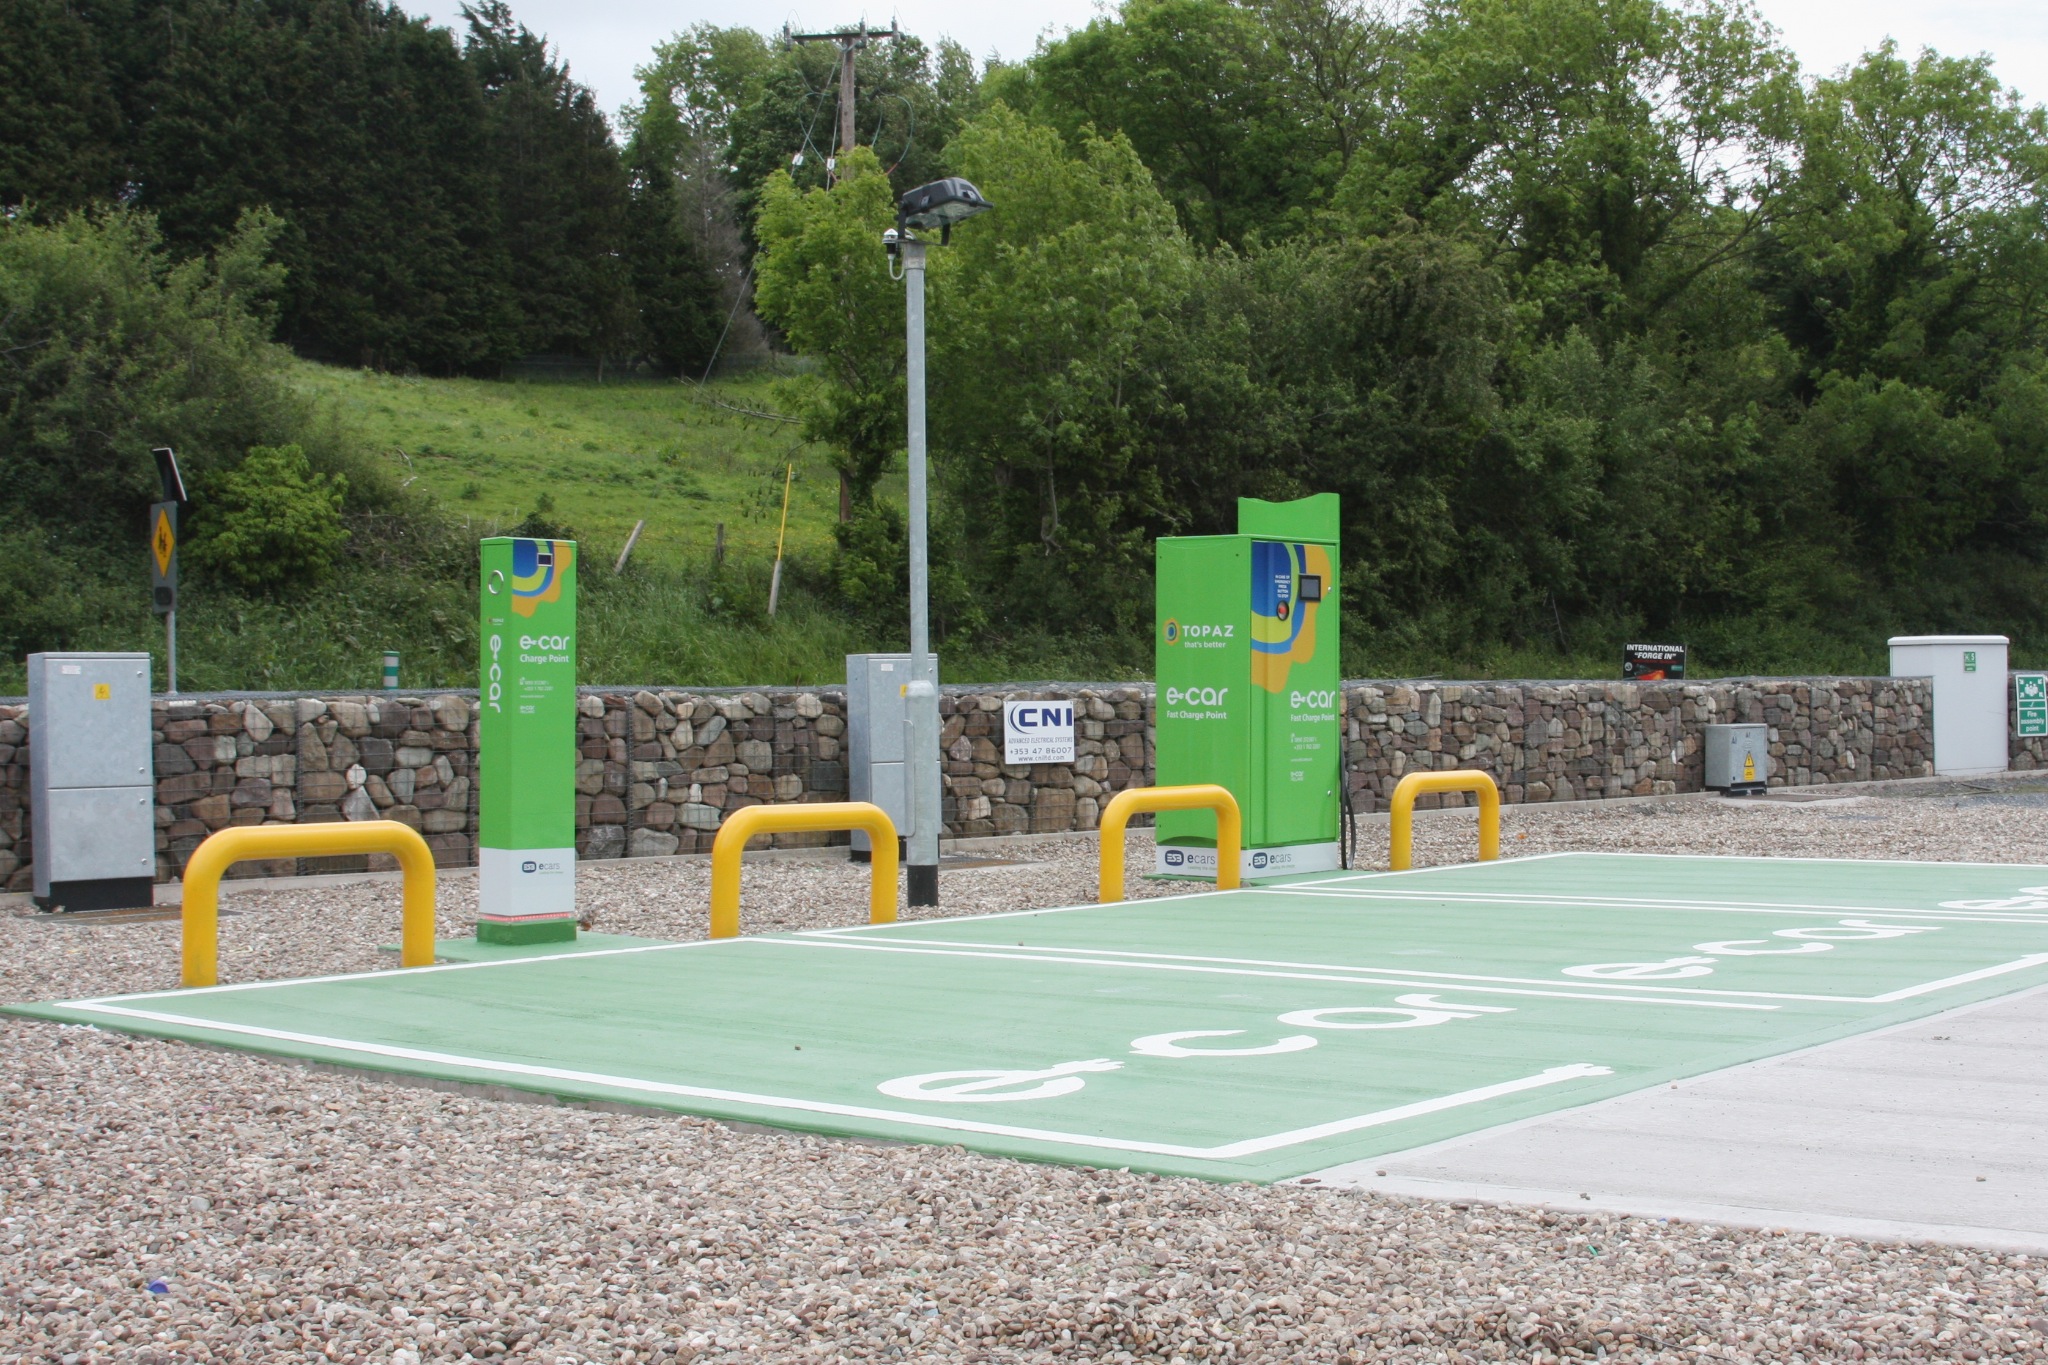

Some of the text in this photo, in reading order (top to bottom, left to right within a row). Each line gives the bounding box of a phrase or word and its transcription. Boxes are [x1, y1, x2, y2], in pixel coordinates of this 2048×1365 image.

[1182, 625, 1234, 637] TOPAZ
[1626, 644, 1684, 652] INTERNATIONAL
[520, 654, 570, 664] Charge Point
[1019, 708, 1072, 727] CNI
[1167, 710, 1227, 720] Fast Charge Point
[1302, 714, 1320, 723] Charge
[1187, 854, 1216, 864] ecars
[1270, 853, 1292, 863] ecars
